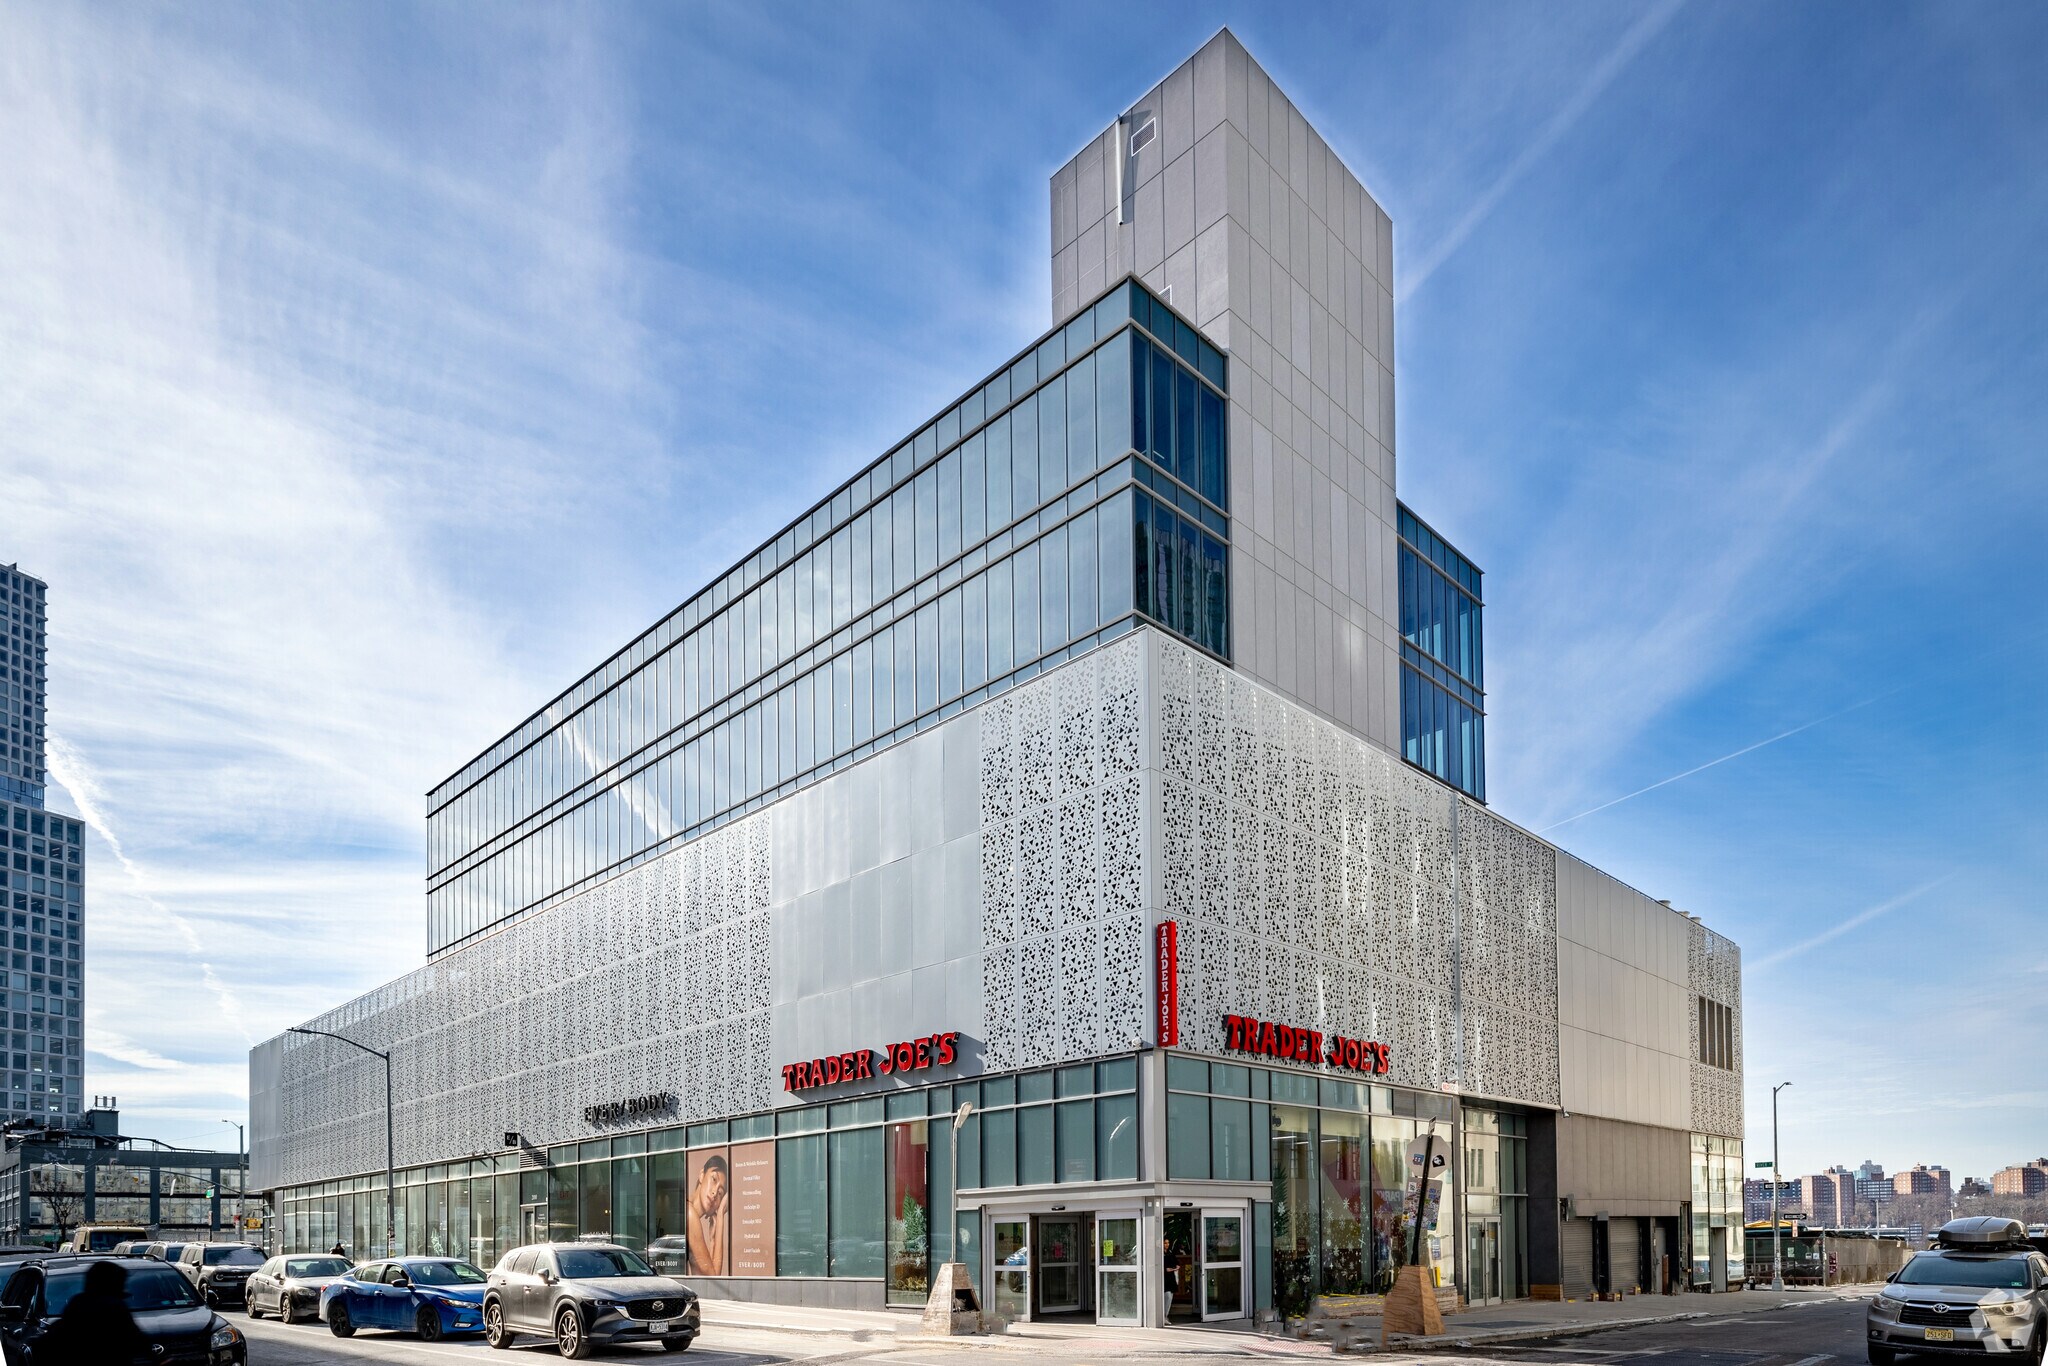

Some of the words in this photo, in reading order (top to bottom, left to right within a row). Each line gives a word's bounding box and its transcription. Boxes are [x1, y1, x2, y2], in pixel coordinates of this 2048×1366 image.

[1161, 925, 1169, 992] TRADER
[782, 1049, 873, 1092] TRADER
[877, 1032, 958, 1075] JOE'S
[1224, 1014, 1324, 1063] TRADER
[1327, 1036, 1391, 1074] JOE'S
